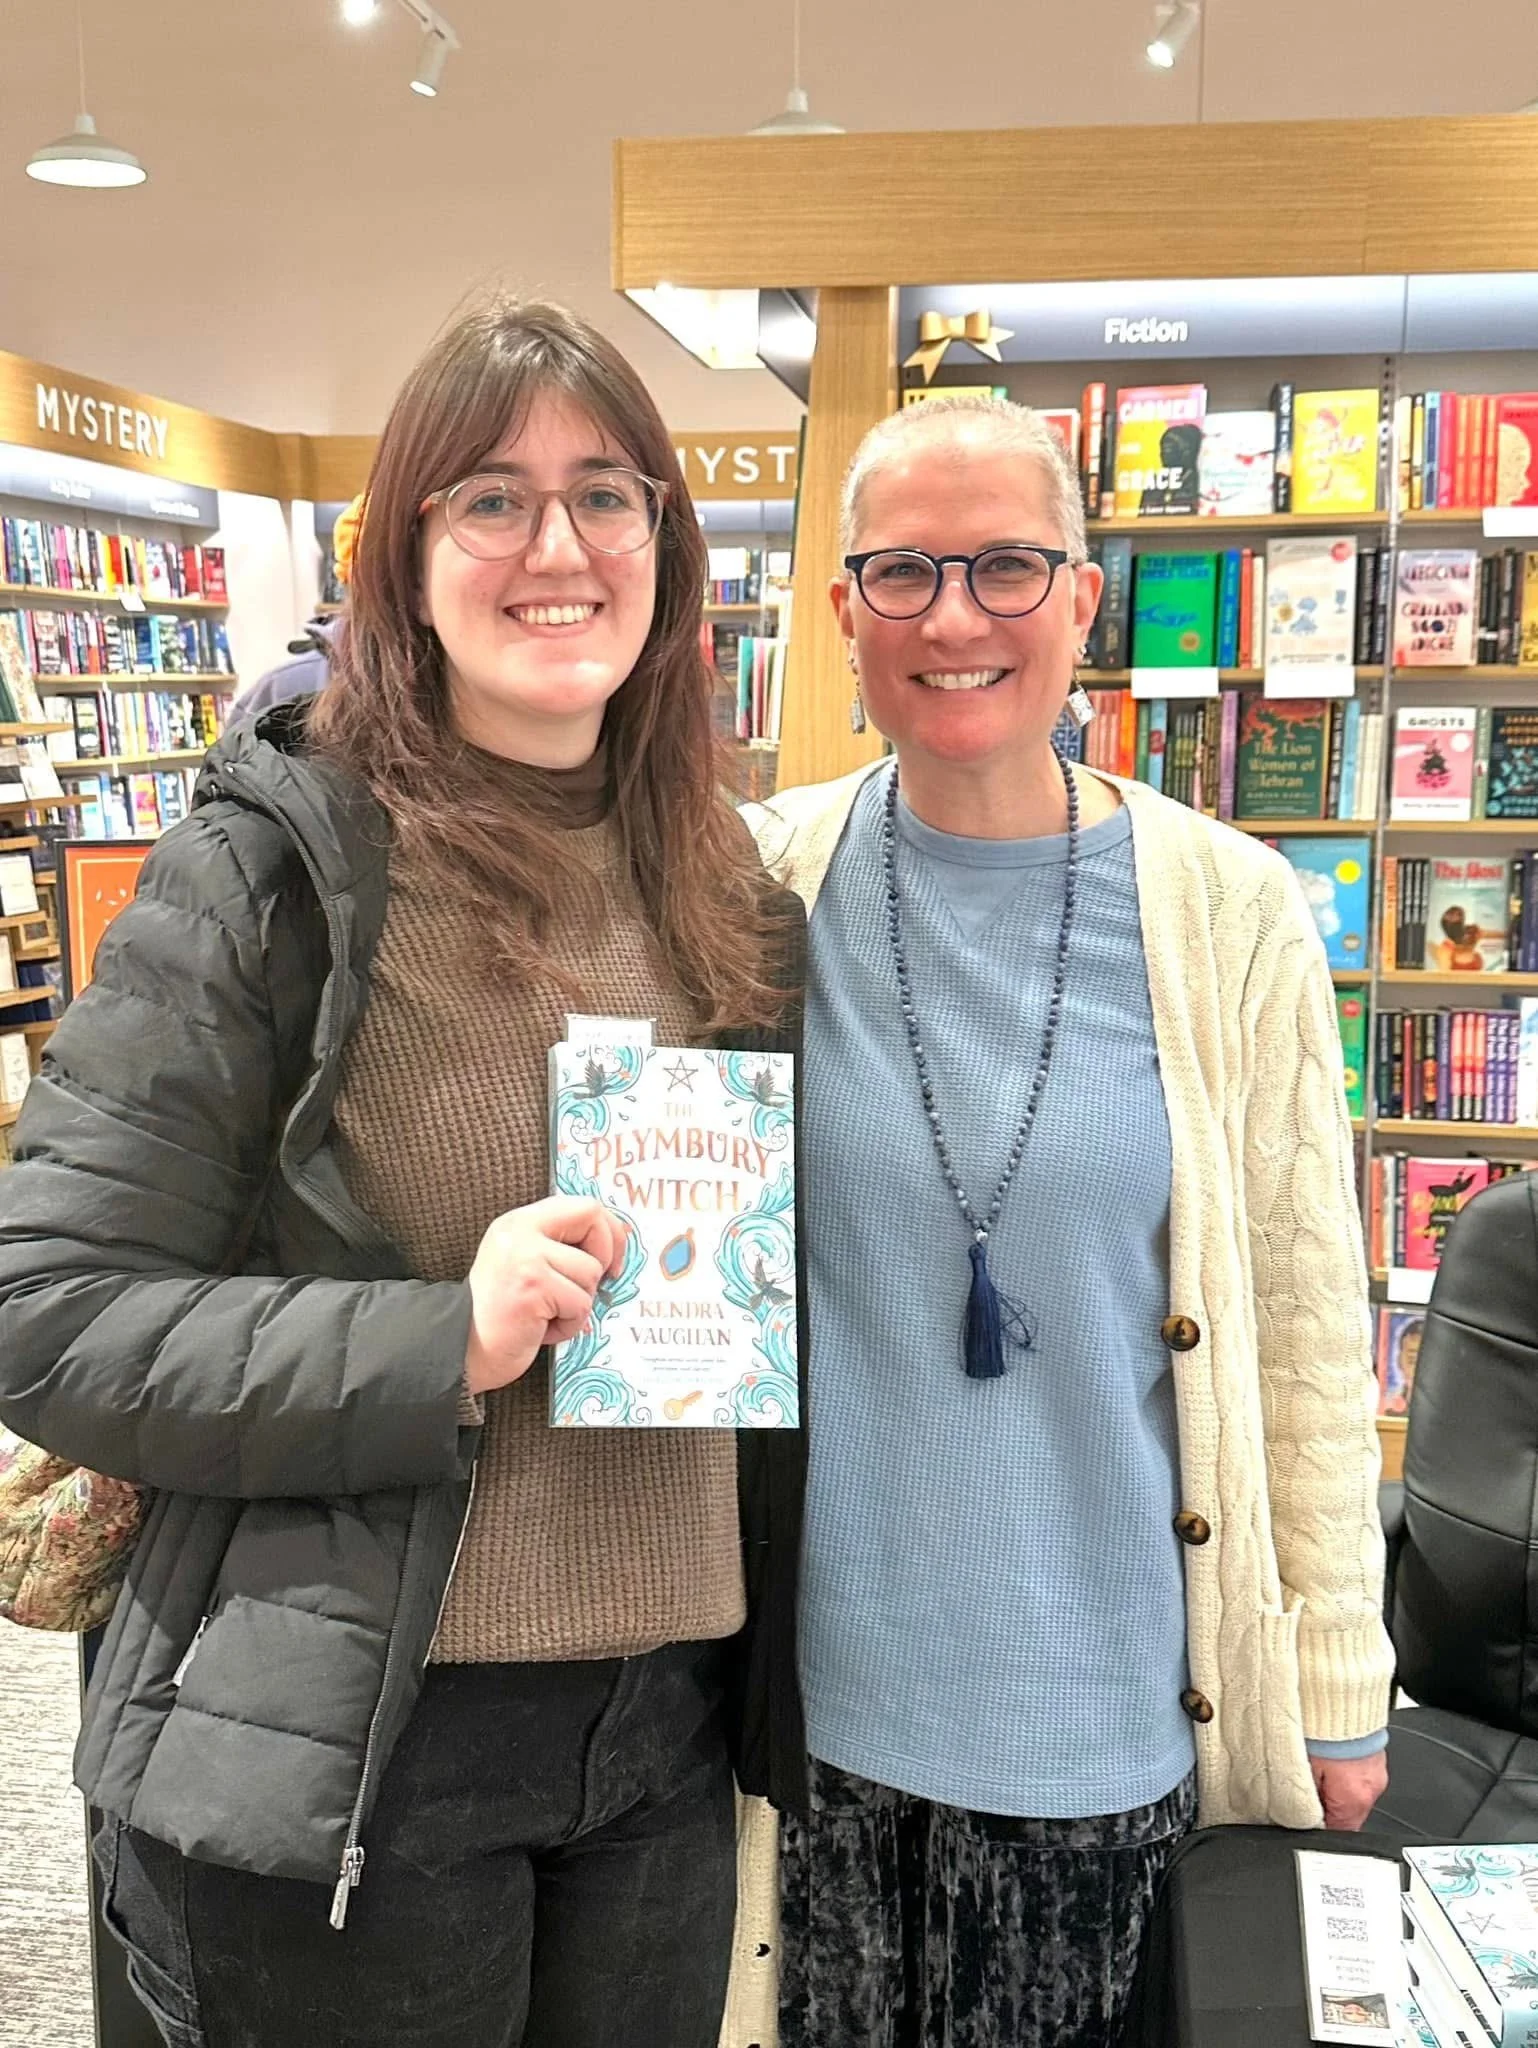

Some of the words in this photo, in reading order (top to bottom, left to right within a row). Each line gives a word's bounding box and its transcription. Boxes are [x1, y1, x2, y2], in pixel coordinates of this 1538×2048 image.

[1104, 316, 1188, 344] Fiction
[36, 382, 168, 460] MYSTERY
[1281, 741, 1312, 756] Lion
[1248, 758, 1297, 771] Women
[586, 1126, 770, 1179] PLYMBURY
[613, 1172, 740, 1212] WITCH
[639, 1300, 725, 1319] KENDRA
[629, 1326, 732, 1346] VAUGHAN
